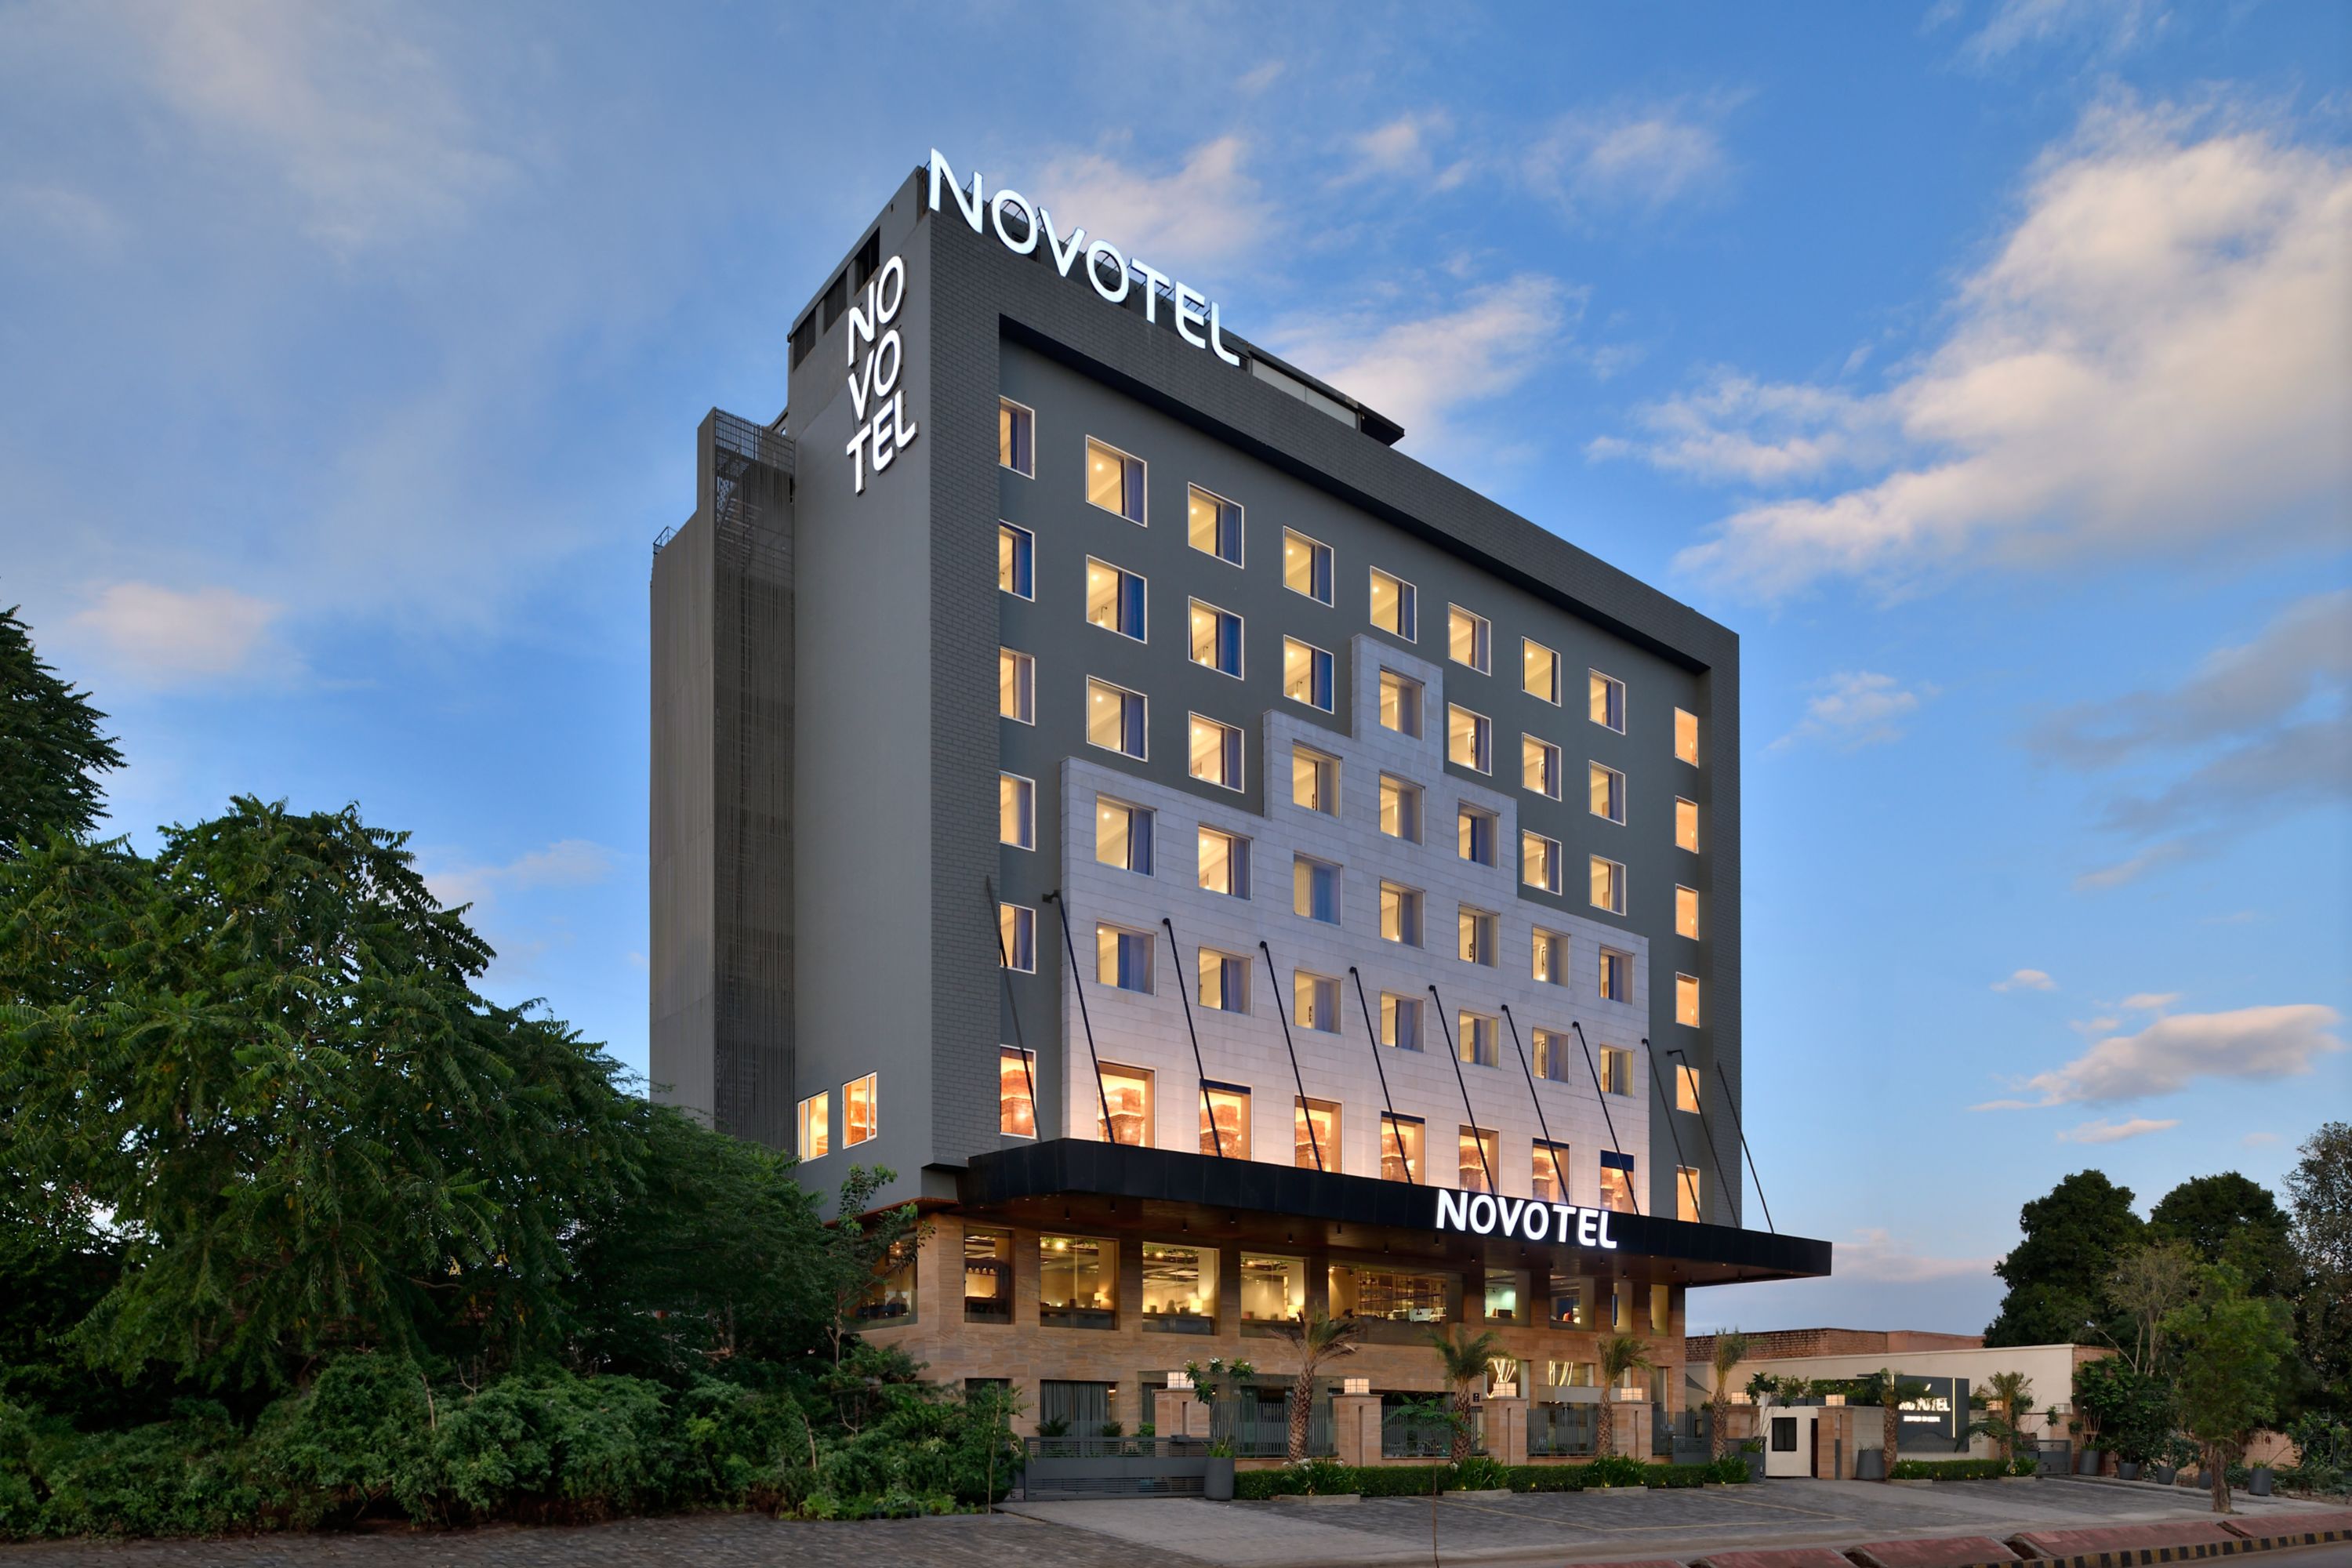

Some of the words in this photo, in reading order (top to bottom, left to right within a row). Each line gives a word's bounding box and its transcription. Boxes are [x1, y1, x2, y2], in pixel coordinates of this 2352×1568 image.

[929, 148, 1240, 367] NOVOTEL
[848, 256, 904, 368] NO
[848, 329, 902, 423] VO
[846, 389, 916, 495] TEL
[1436, 1189, 1618, 1249] NOVOTEL
